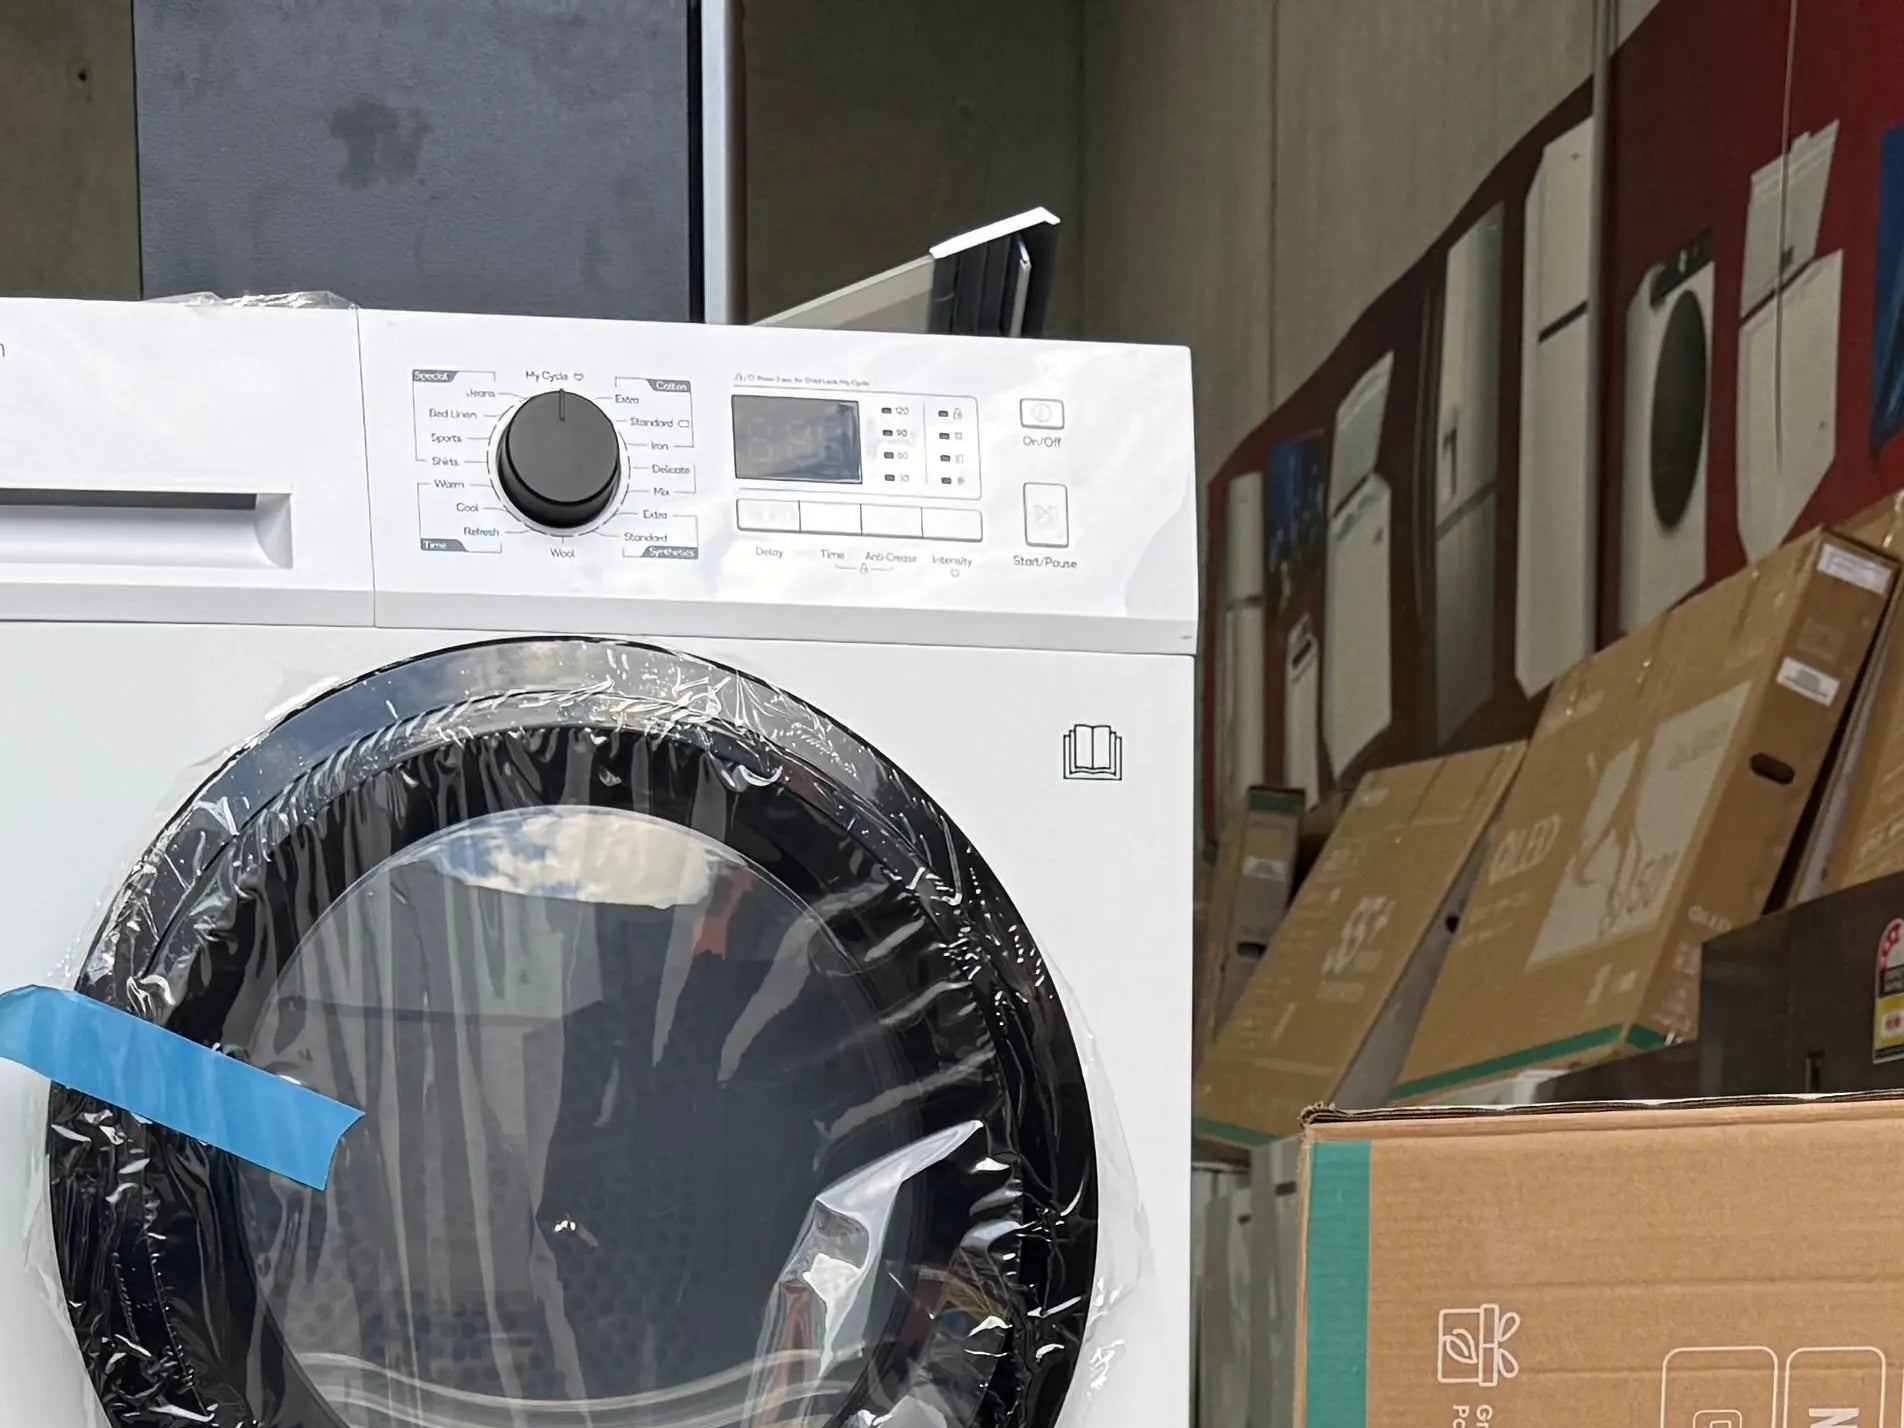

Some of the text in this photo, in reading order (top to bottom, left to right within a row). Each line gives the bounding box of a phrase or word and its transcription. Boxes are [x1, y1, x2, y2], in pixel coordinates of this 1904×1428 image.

[615, 395, 639, 404] Extra
[431, 433, 462, 443] Sports
[1023, 437, 1062, 448] On/Off
[434, 480, 465, 489] Warm
[457, 503, 479, 512] Cool
[643, 510, 667, 519] Extra
[464, 526, 499, 536] Refresh
[624, 533, 667, 543] Standard
[550, 548, 576, 558] Wool
[755, 547, 784, 559] Delay
[821, 549, 972, 568] Time Anti-Crease Intensity
[1014, 555, 1077, 570] Start/Pause
